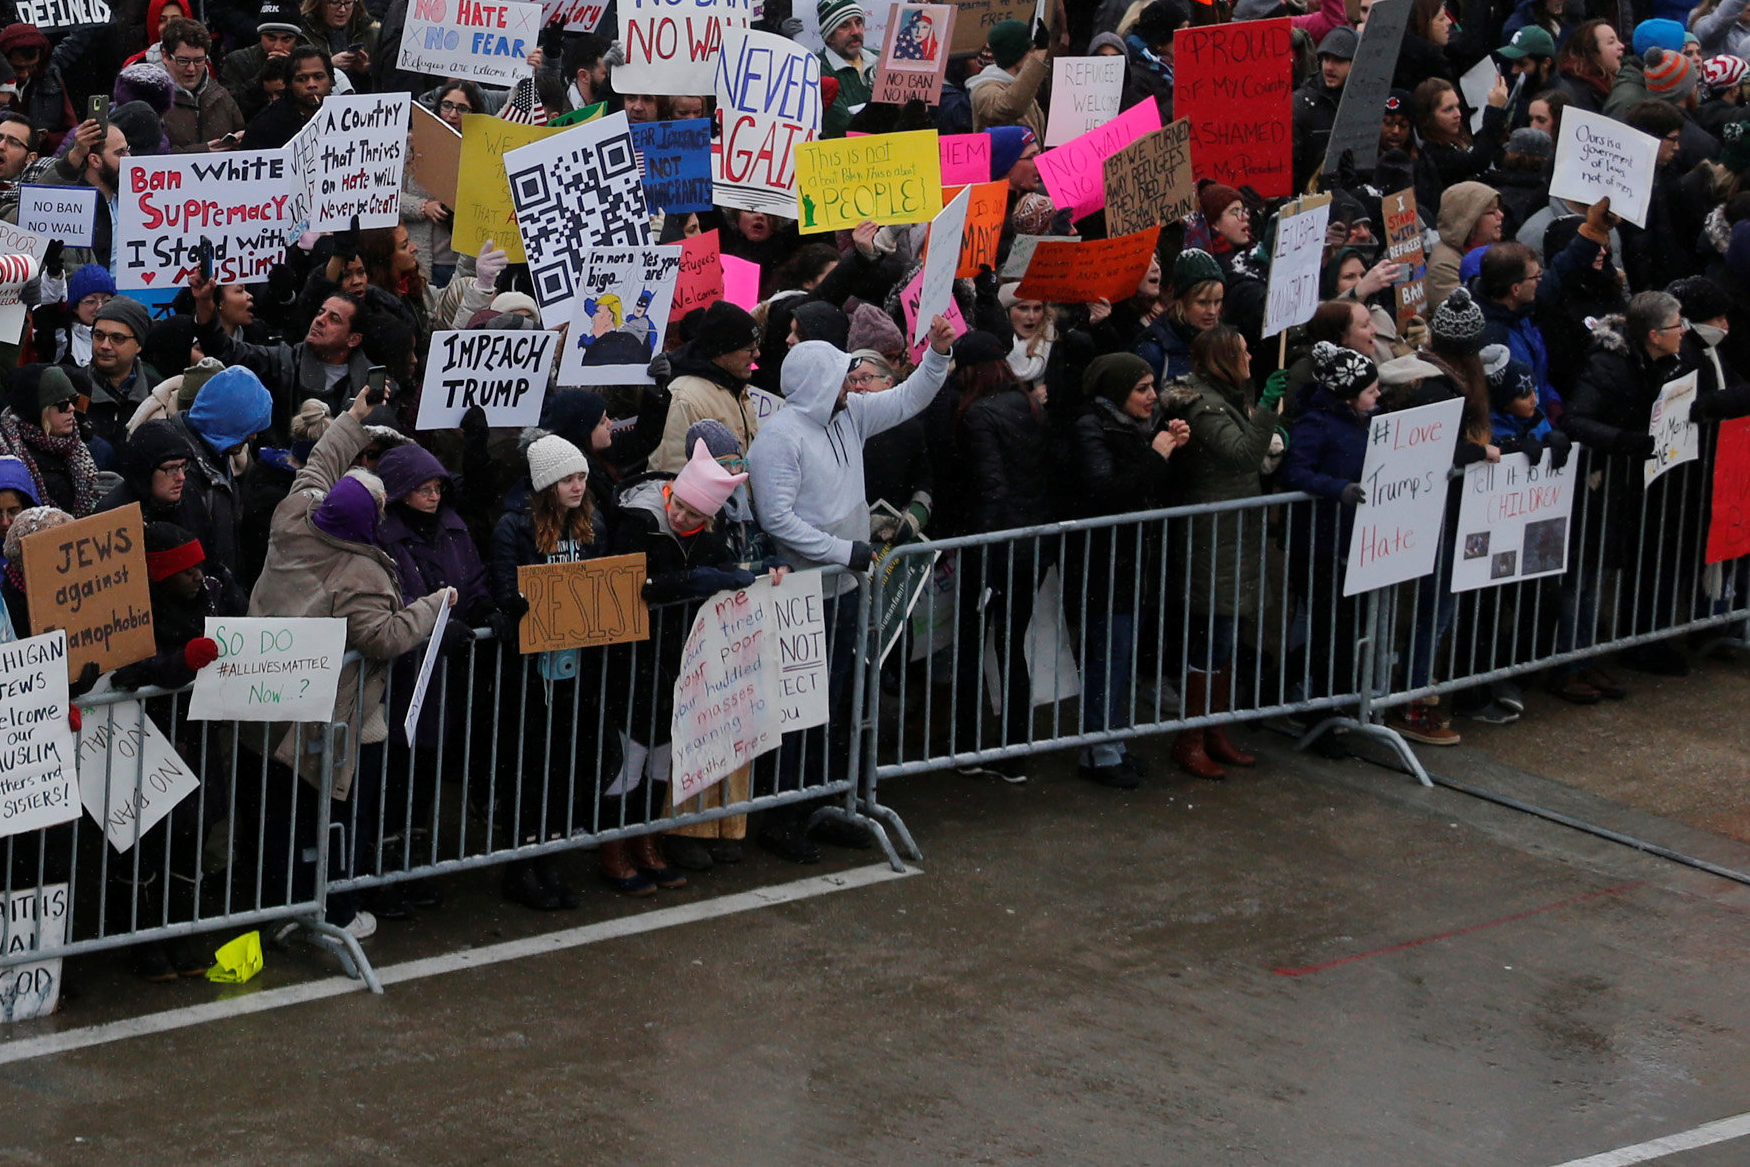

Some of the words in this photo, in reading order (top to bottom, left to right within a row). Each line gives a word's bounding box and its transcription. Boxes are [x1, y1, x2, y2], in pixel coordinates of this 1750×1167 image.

[456, 0, 508, 28] HATE
[424, 26, 459, 50] NO
[472, 32, 526, 58] FEAR
[625, 17, 678, 64] NO
[1183, 29, 1291, 64] PROUD
[714, 30, 820, 117] NEVER
[908, 74, 934, 89] BAN
[1576, 125, 1605, 144] Ours
[1579, 144, 1633, 168] government
[130, 166, 182, 194] Ban
[33, 201, 52, 214] NO
[56, 201, 82, 214] BAN
[1388, 210, 1415, 230] STAND
[28, 220, 49, 234] NO
[52, 221, 84, 234] WALL
[1402, 282, 1424, 305] BAN
[442, 333, 552, 374] IMPEACH
[441, 377, 530, 410] TRUMP
[1366, 464, 1433, 507] Trumps
[1486, 484, 1562, 525] CHILDREN
[55, 527, 133, 574] JEWS
[1359, 527, 1417, 568] Hate
[56, 565, 129, 613] against
[527, 564, 642, 646] RESIST
[217, 626, 243, 657] SO
[260, 629, 293, 651] DO
[781, 632, 824, 660] NOT
[217, 656, 330, 678] #ALLLIVESMATTER
[734, 731, 770, 762] Free
[3, 783, 69, 819] SISTERS!
